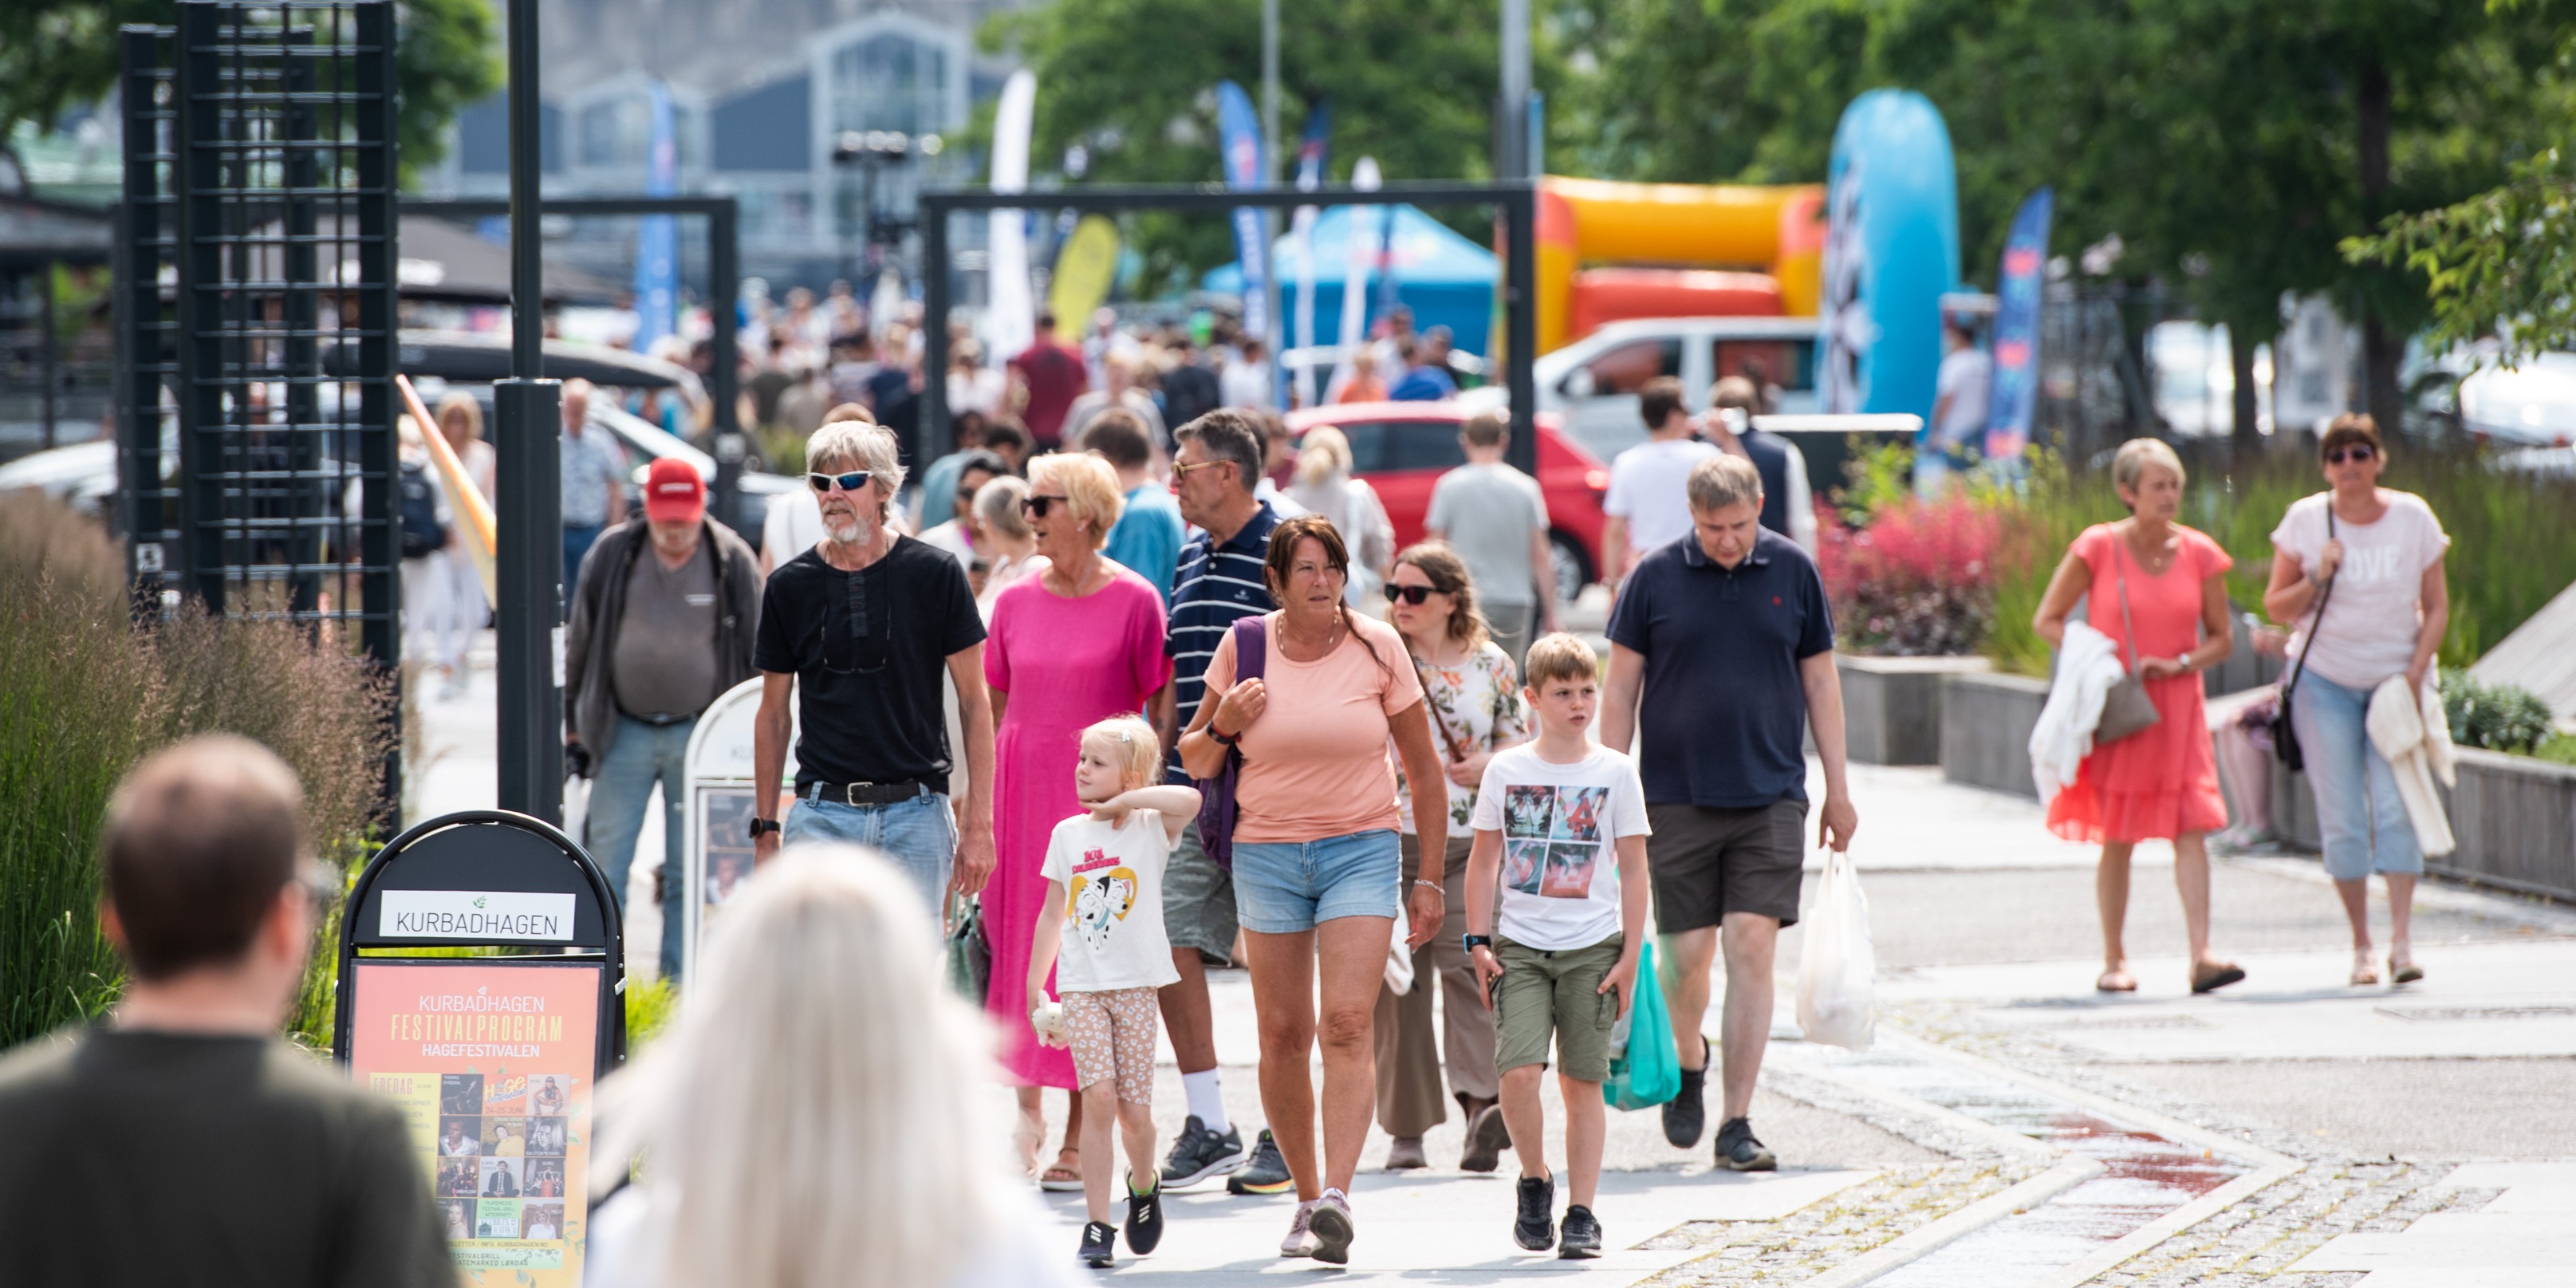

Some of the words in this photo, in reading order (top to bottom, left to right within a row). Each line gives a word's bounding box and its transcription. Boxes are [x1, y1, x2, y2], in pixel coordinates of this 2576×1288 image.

[2345, 545, 2401, 584] OVE
[397, 912, 557, 935] KURBADHAGEN
[419, 995, 545, 1012] KURBADHAGEN
[391, 1014, 563, 1042] FESTIVALPROGRAM
[422, 1043, 541, 1058] HAGEFESTIVALEN
[373, 1077, 413, 1095] FREDAG
